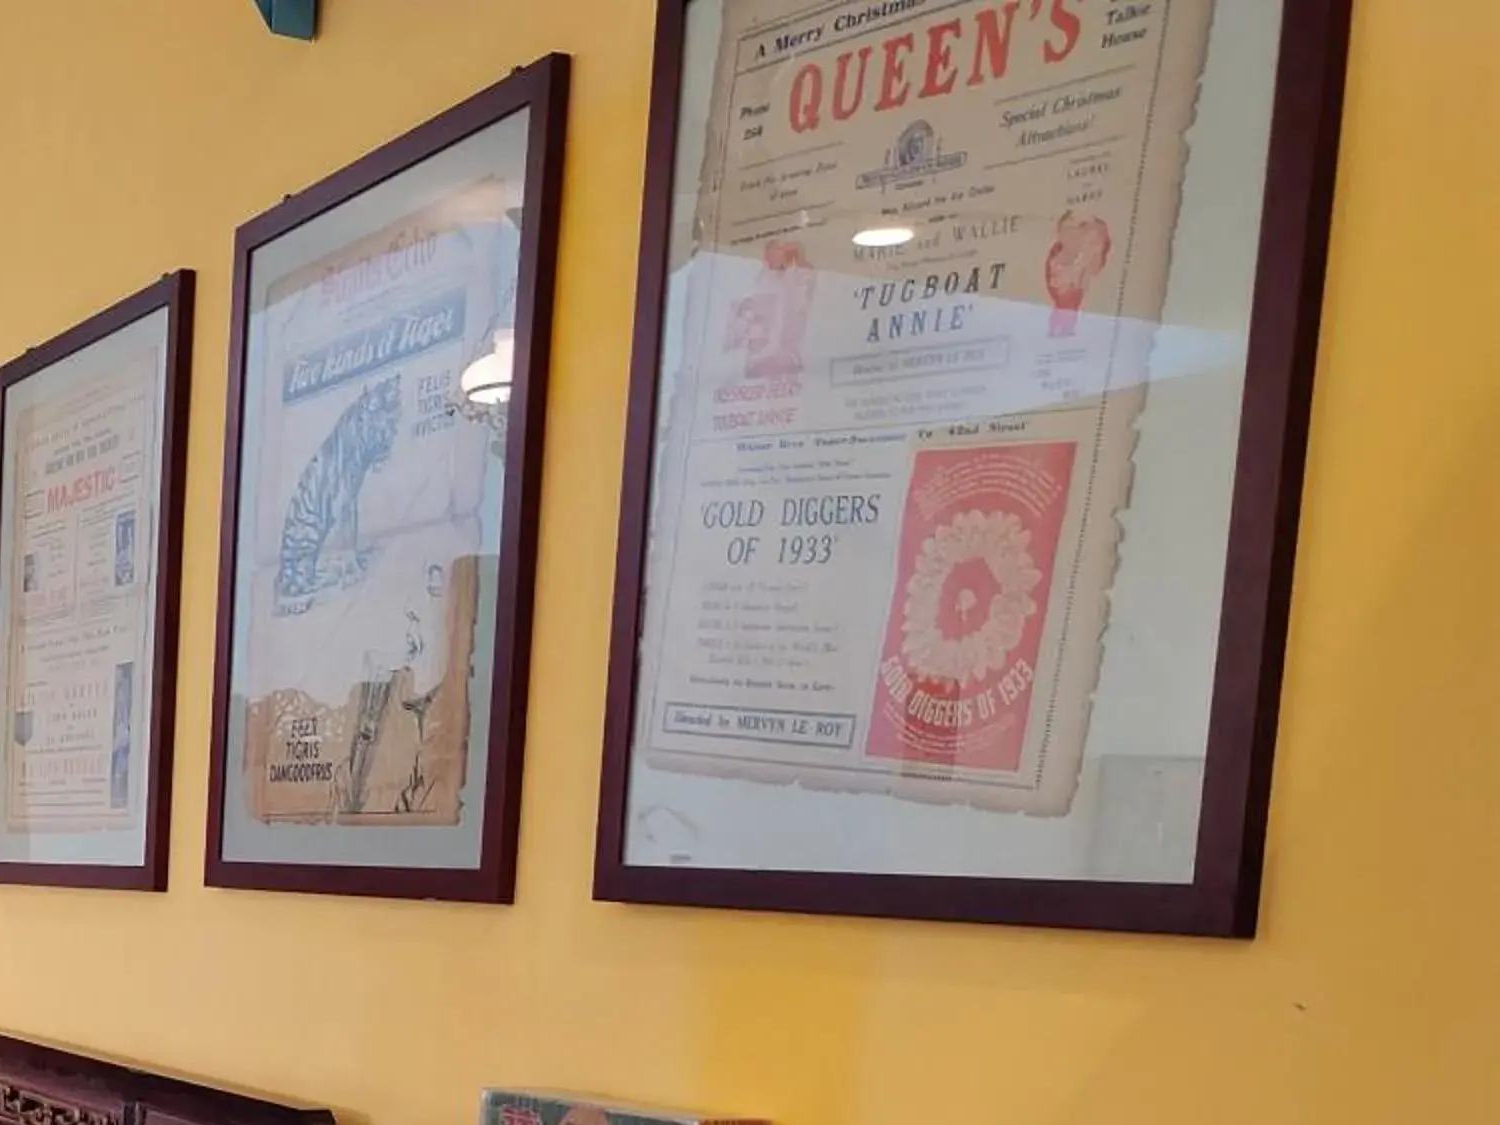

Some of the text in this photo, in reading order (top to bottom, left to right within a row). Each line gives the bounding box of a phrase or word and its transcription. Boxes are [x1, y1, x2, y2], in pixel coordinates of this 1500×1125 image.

[773, 23, 825, 53] Merry
[789, 0, 1081, 134] QUEEN'S
[1000, 86, 1123, 129] Special Christmas
[953, 214, 1021, 241] WALLIE
[780, 493, 882, 528] DIGGERS
[727, 535, 761, 566] OF
[907, 690, 974, 730] DIGGERS
[976, 688, 997, 720] OF
[997, 657, 1035, 706] 1933
